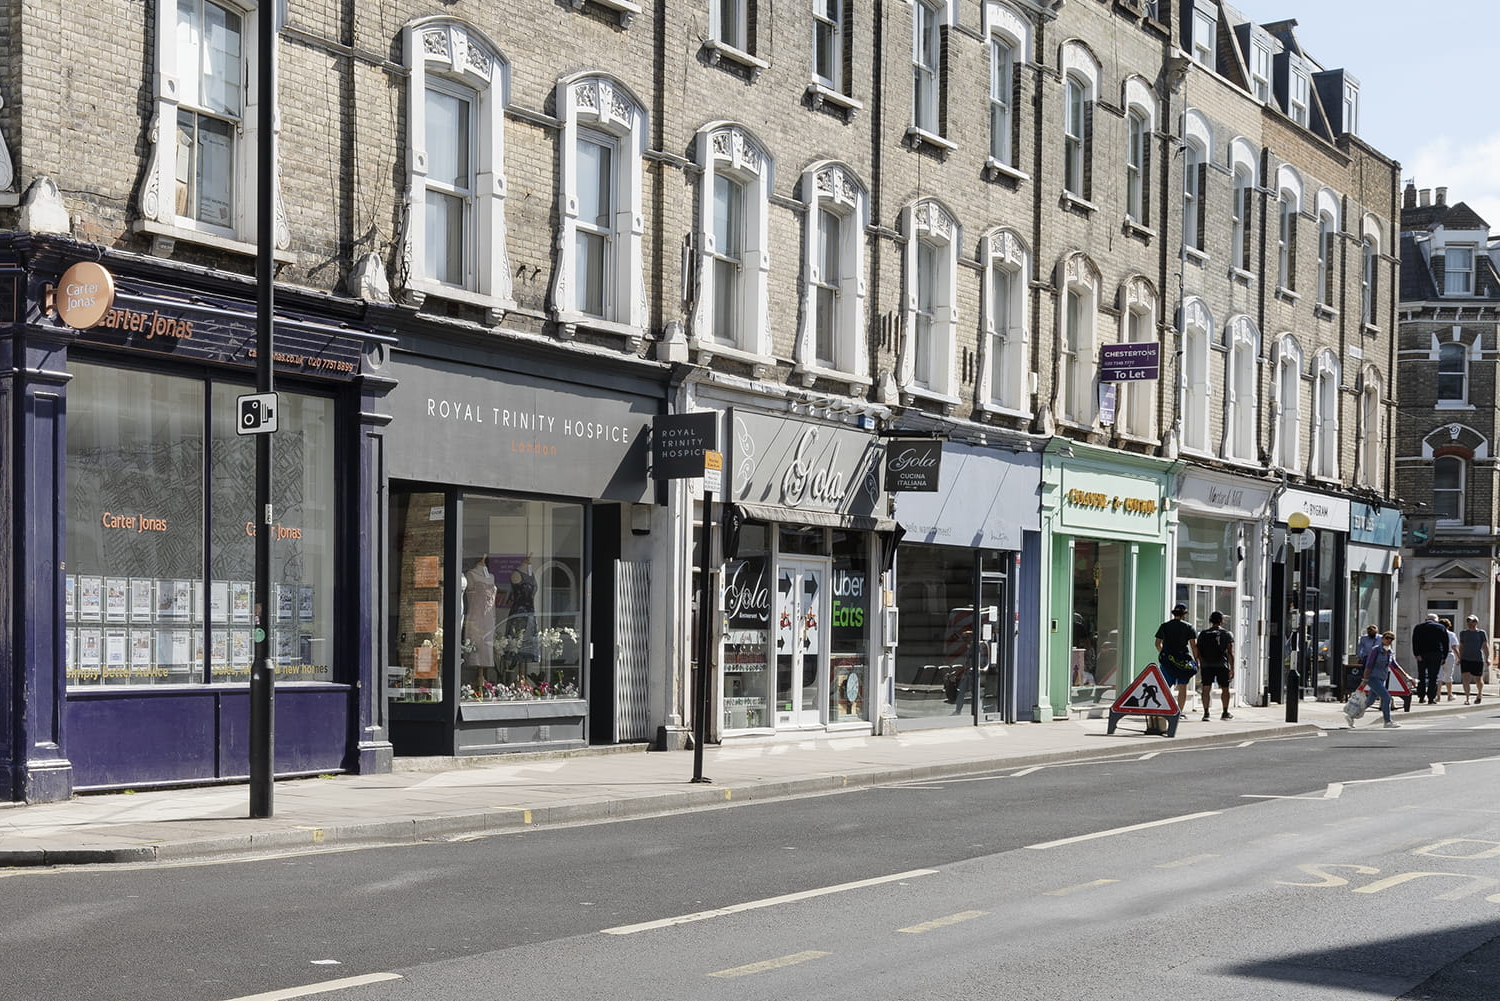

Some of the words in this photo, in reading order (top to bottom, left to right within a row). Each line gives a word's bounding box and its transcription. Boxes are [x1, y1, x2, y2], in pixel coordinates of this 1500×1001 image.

[66, 283, 98, 296] Carter
[66, 296, 96, 312] Jonas
[146, 310, 194, 340] Jonas
[307, 356, 321, 367] 020
[1104, 350, 1157, 358] CHESTERTONS
[1114, 371, 1126, 379] To
[1129, 370, 1145, 378] Let
[427, 398, 483, 423] ROYAL
[492, 408, 555, 433] TRINITY
[564, 419, 628, 443] HOSPICE
[662, 428, 696, 437] ROYAL
[510, 439, 558, 456] London
[662, 438, 703, 448] TRINITY
[888, 448, 937, 471] Gola
[102, 512, 136, 529] Carter
[137, 514, 167, 533] Jonas
[245, 522, 275, 537] Car
[276, 524, 302, 541] Jonas
[833, 569, 864, 597] Uber
[832, 600, 864, 627] Eats
[101, 666, 132, 678] Better
[284, 665, 300, 675] new
[301, 664, 328, 675] homes
